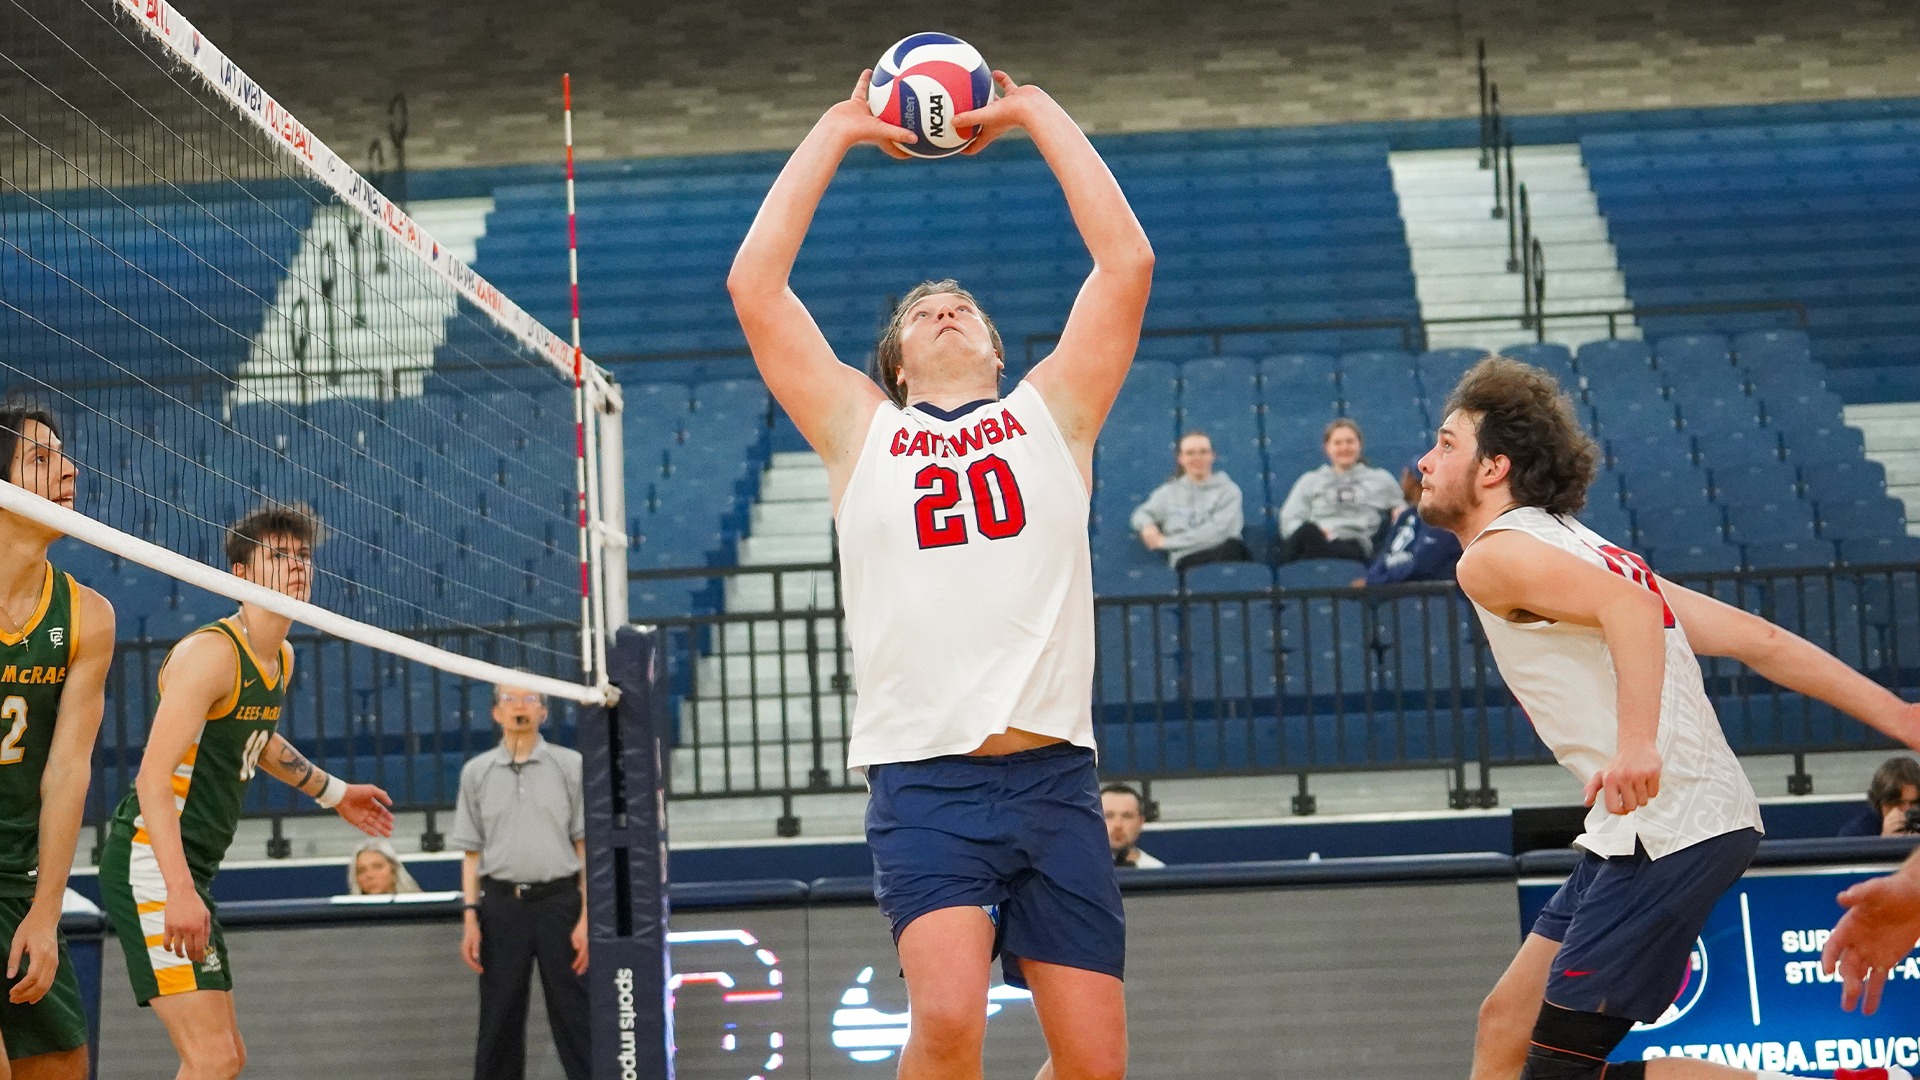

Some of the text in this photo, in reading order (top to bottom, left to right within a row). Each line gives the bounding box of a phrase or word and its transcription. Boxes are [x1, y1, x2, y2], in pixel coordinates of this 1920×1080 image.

[904, 96, 916, 129] olten
[930, 94, 943, 138] NCAA
[890, 408, 1027, 457] CATAWBA
[914, 453, 1027, 550] 20
[0, 695, 29, 765] 2
[1782, 929, 1836, 953] SUP
[1642, 1037, 1920, 1072] AWBA.EDU/C
